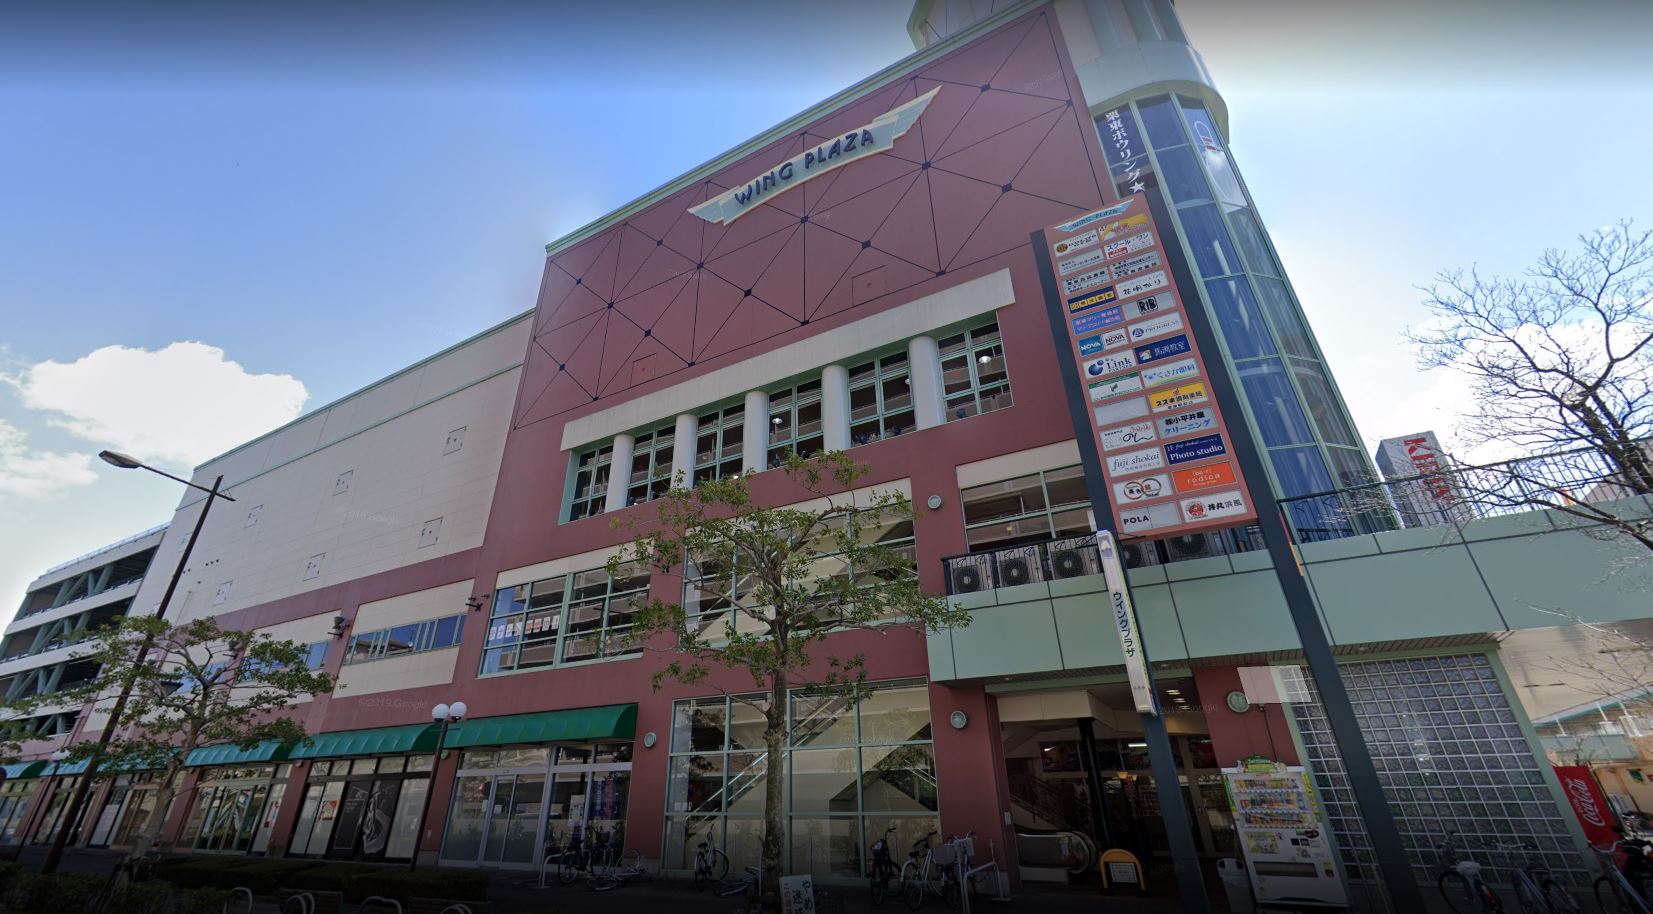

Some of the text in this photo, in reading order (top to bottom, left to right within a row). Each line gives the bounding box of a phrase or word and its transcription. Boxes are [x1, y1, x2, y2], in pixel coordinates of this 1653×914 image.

[734, 129, 874, 205] WING PLAZA
[1105, 333, 1125, 344] NOVA
[1081, 341, 1102, 352] NOVA
[1106, 357, 1132, 370] Link
[1164, 418, 1211, 436] クリーニング
[1170, 444, 1223, 462] Photo studio
[1112, 456, 1129, 472] fuji
[1131, 451, 1160, 465] shokai
[1123, 515, 1150, 526] POLA
